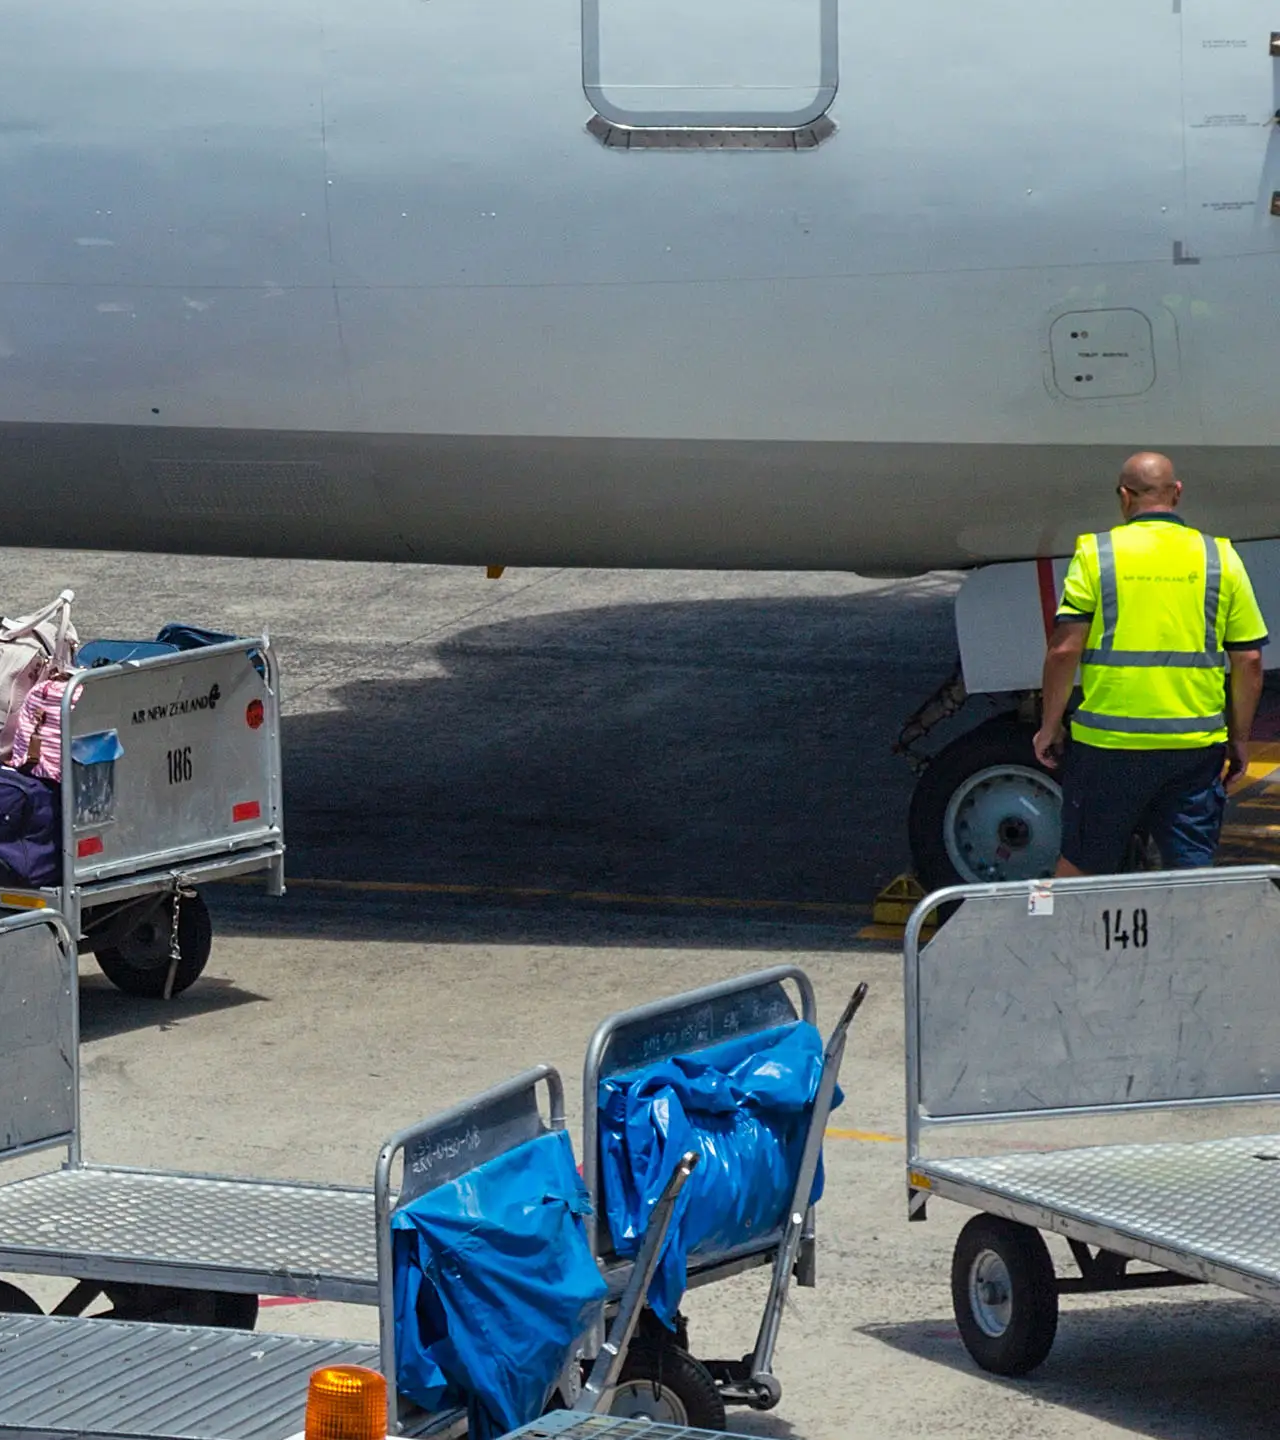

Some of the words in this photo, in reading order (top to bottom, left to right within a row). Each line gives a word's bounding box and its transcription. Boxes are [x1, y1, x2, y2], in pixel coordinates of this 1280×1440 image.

[131, 709, 146, 725] AIR
[147, 704, 168, 721] NEW
[169, 695, 209, 718] ZEALAND
[167, 746, 193, 785] 186
[1102, 908, 1149, 951] 148
